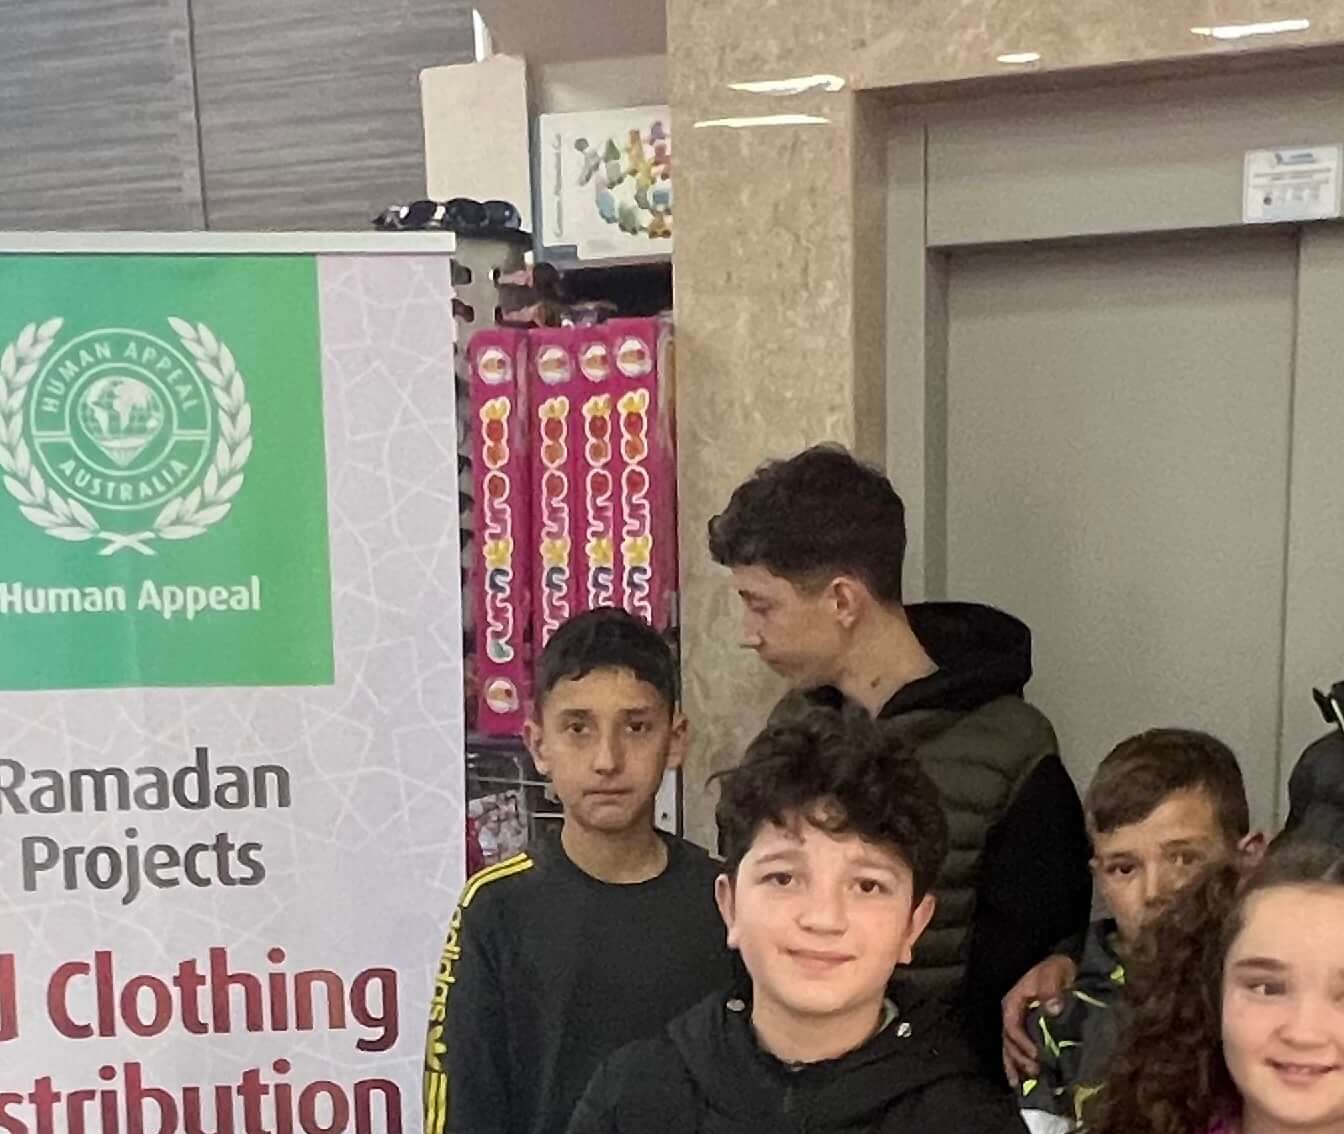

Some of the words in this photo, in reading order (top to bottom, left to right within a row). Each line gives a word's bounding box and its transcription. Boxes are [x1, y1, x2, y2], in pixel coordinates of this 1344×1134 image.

[42, 342, 112, 413] HUMAN
[123, 341, 198, 412] APPEAL
[59, 459, 189, 502] AUSTRALIA
[137, 575, 261, 620] Appeal
[22, 828, 266, 905] Projects
[46, 947, 400, 1052] Clothing
